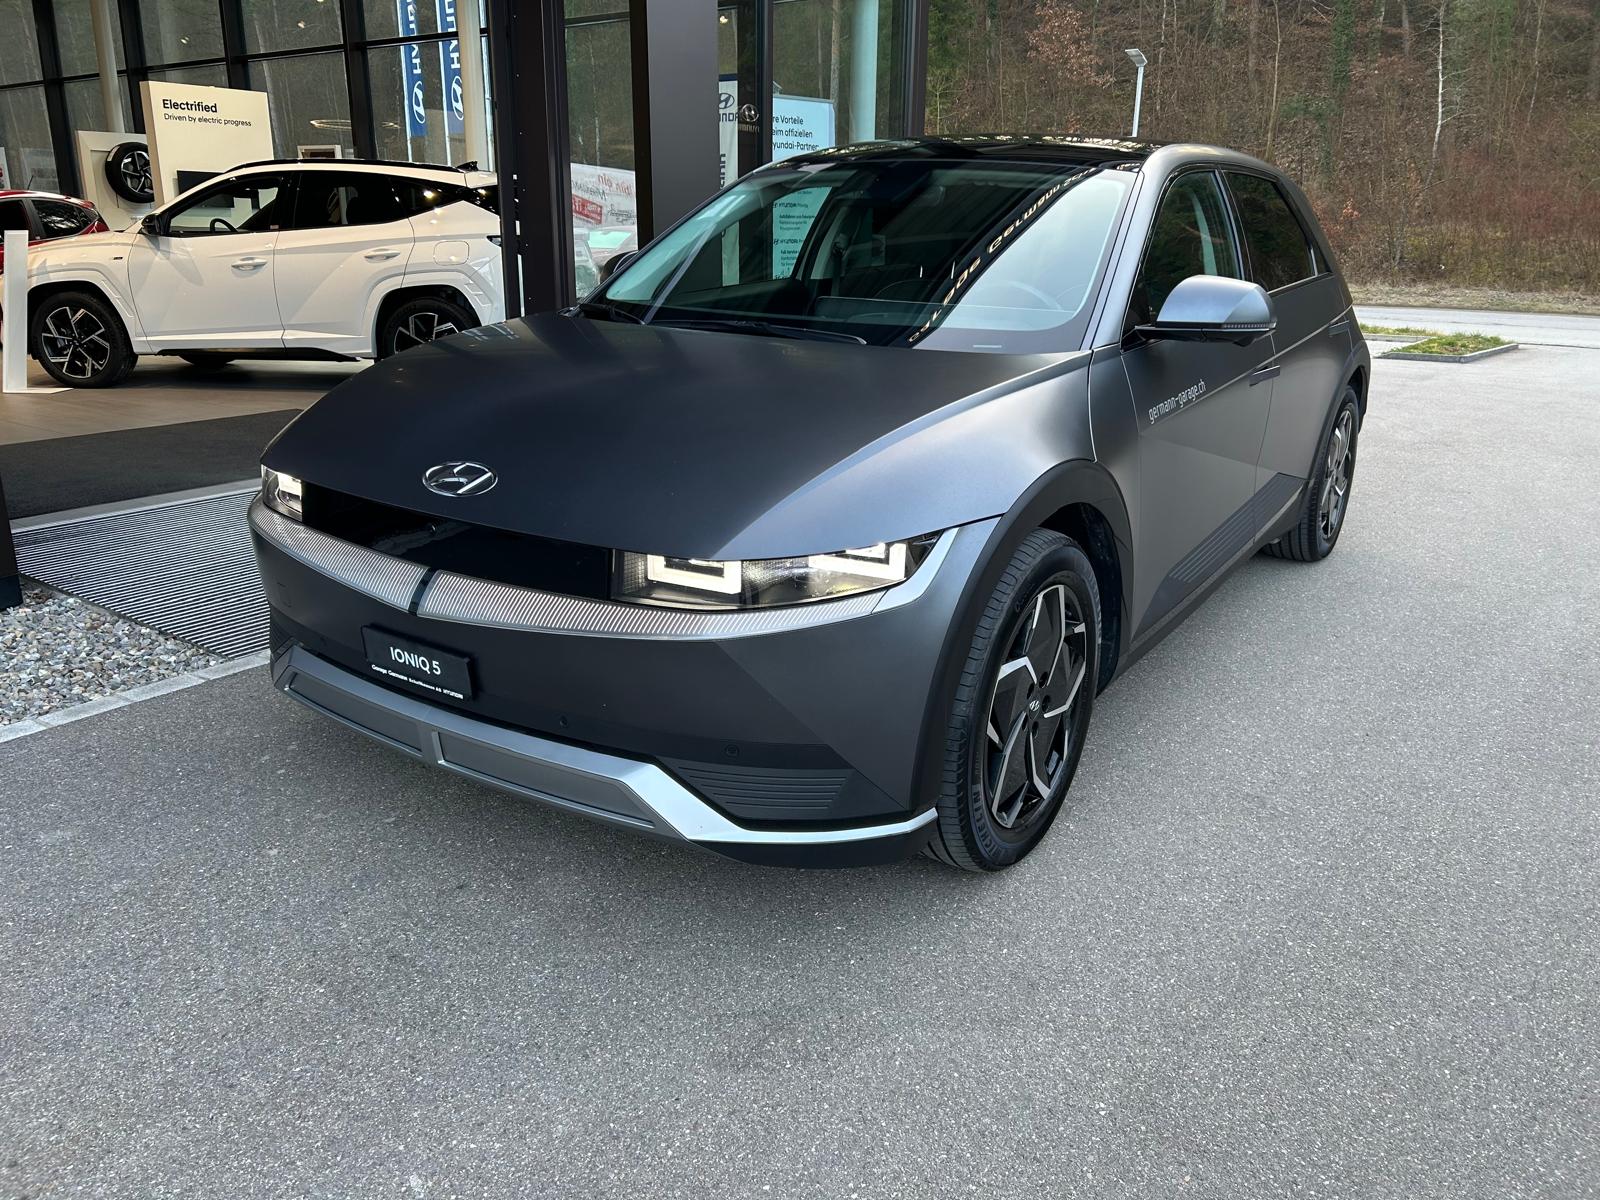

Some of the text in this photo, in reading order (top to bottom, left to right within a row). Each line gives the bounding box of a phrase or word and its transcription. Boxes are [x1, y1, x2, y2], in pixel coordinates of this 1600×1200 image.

[162, 99, 217, 113] Electrified
[163, 113, 252, 127] Driven by electric progress
[780, 115, 804, 125] Vorteile
[772, 127, 813, 139] eim offiziellen
[1148, 379, 1206, 425] germann-garage.ch
[389, 646, 442, 675] IONIQ 5
